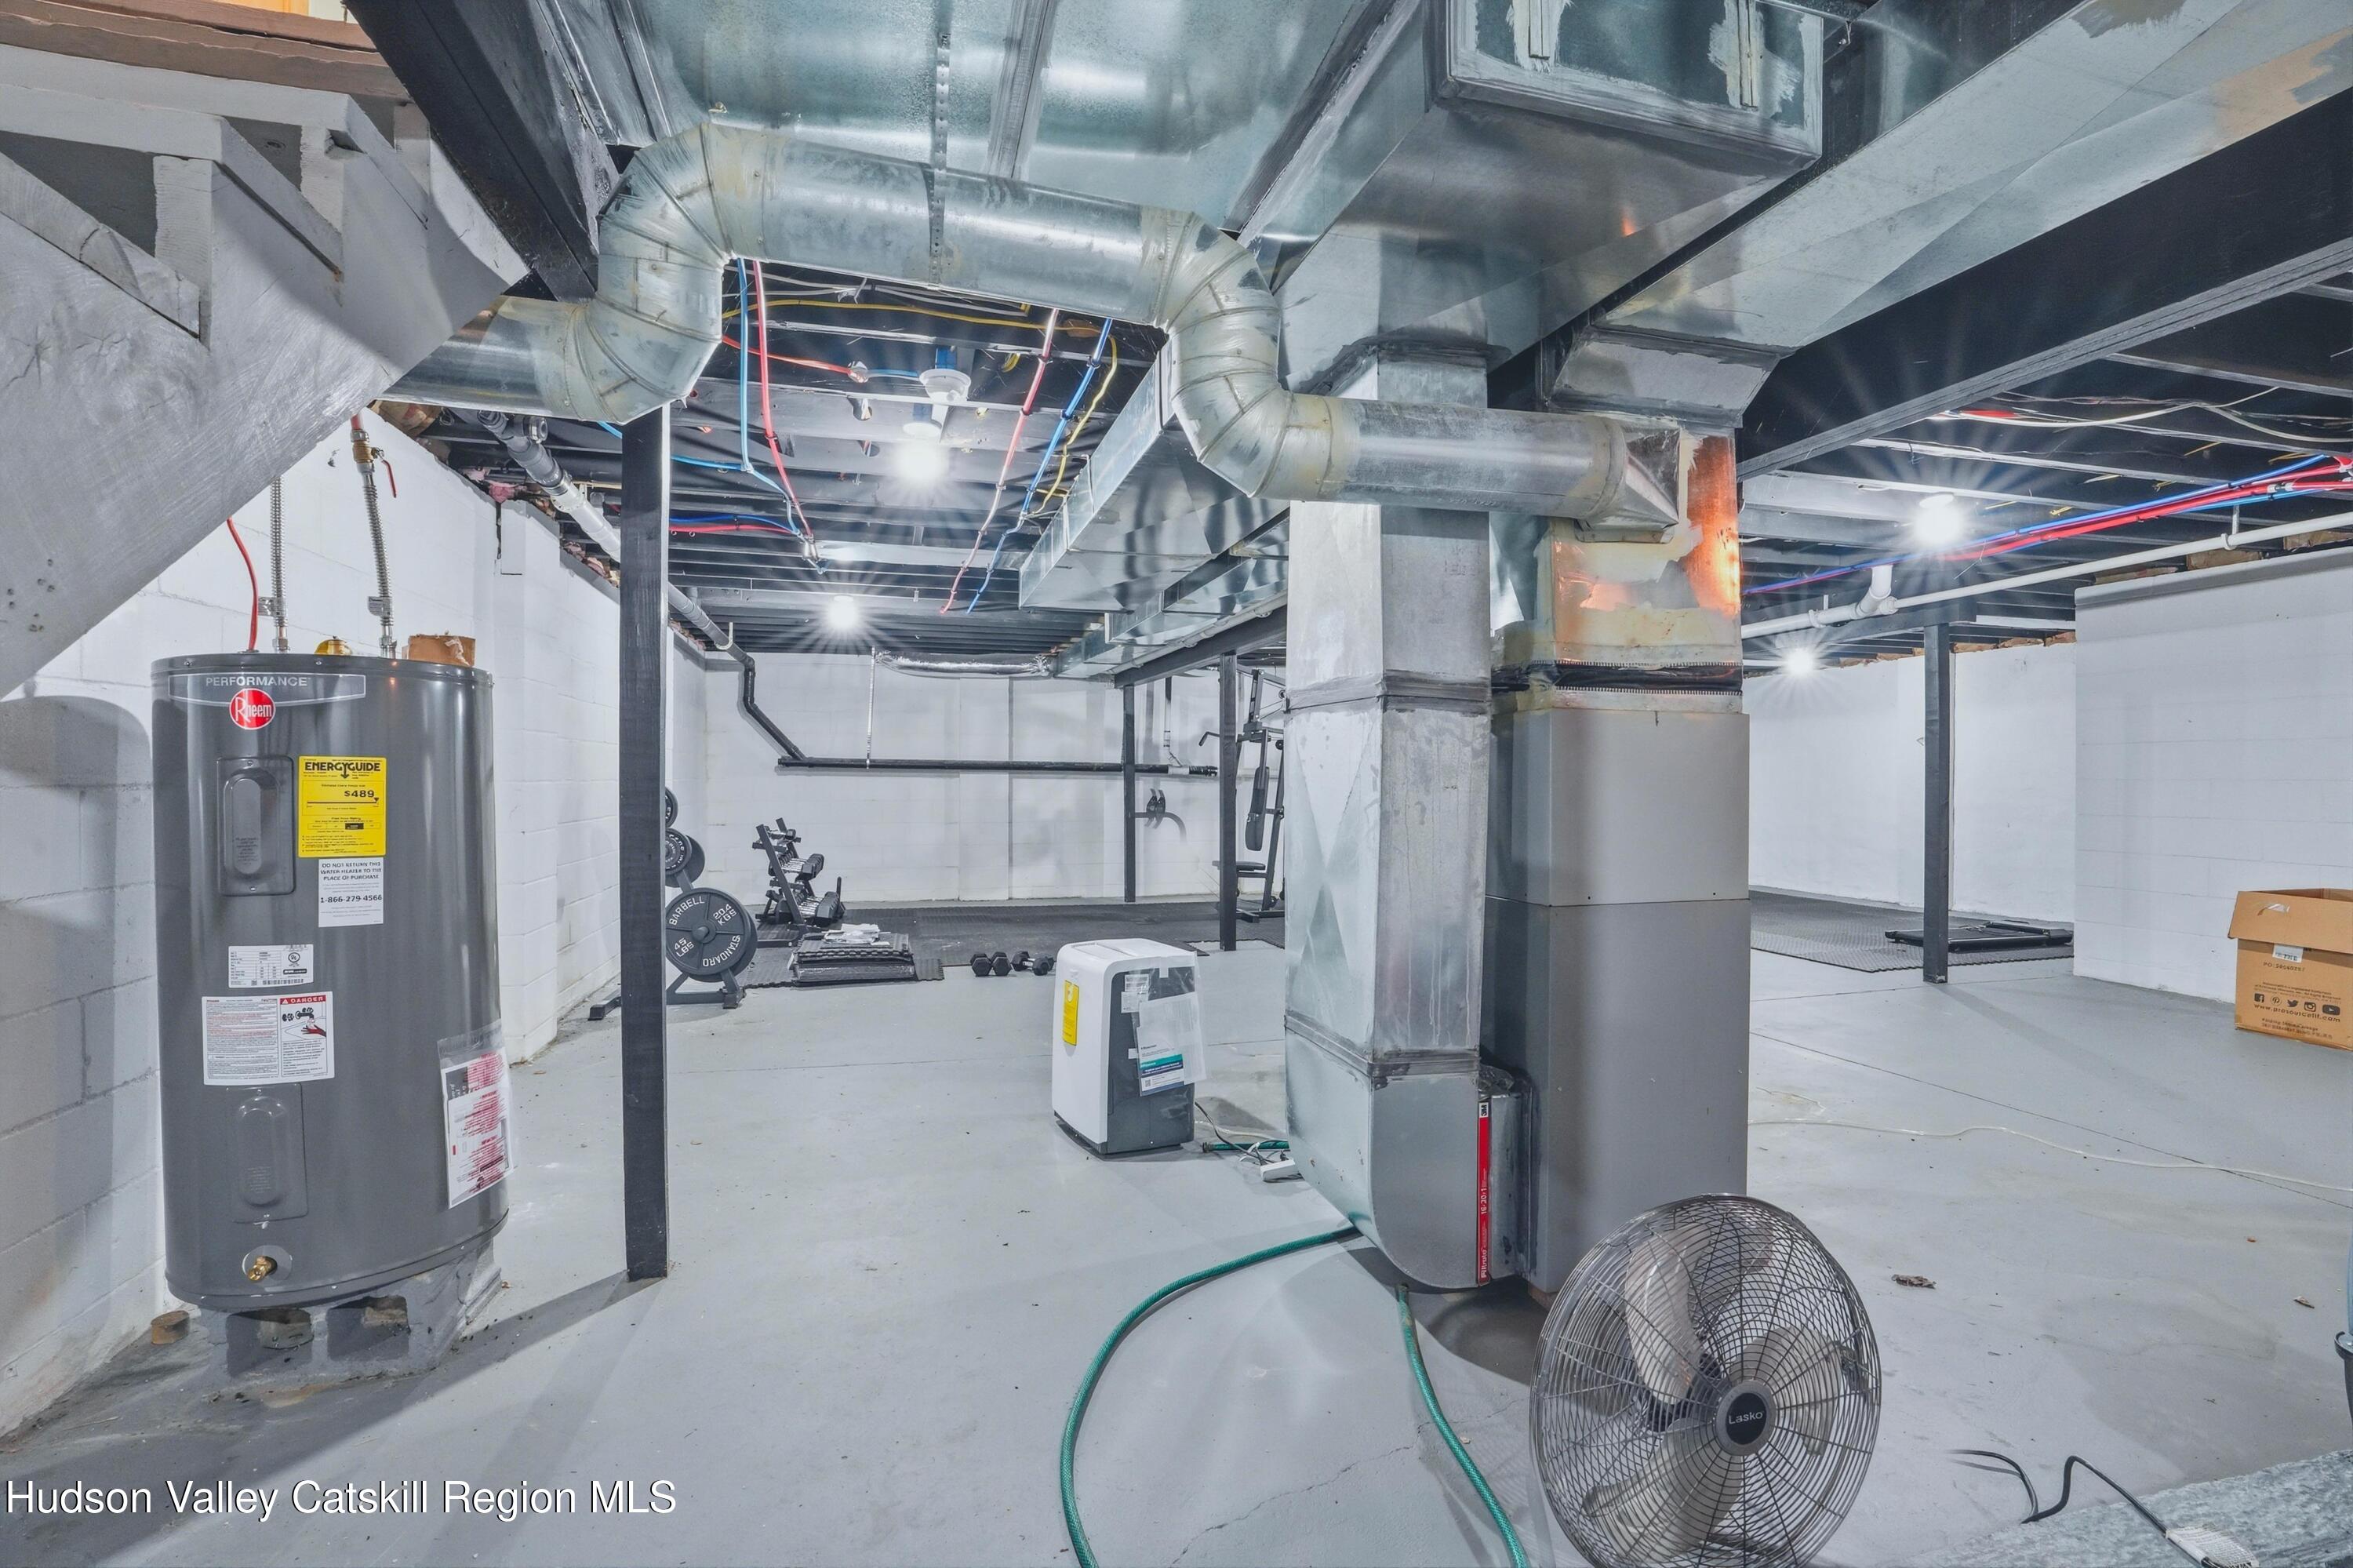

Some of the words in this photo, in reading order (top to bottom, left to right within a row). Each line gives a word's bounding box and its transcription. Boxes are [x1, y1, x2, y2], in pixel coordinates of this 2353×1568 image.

[205, 676, 308, 686] PERFORMANCE
[235, 697, 272, 722] Rheem
[304, 762, 381, 773] ENERGYGUIDE
[669, 896, 705, 926] BARBELL
[717, 909, 737, 926] KGS
[675, 937, 687, 950] 45
[675, 941, 694, 957] LBS
[702, 935, 741, 967] STANDARD
[1480, 1104, 1488, 1116] 3M
[1729, 1412, 1763, 1424] Lasko
